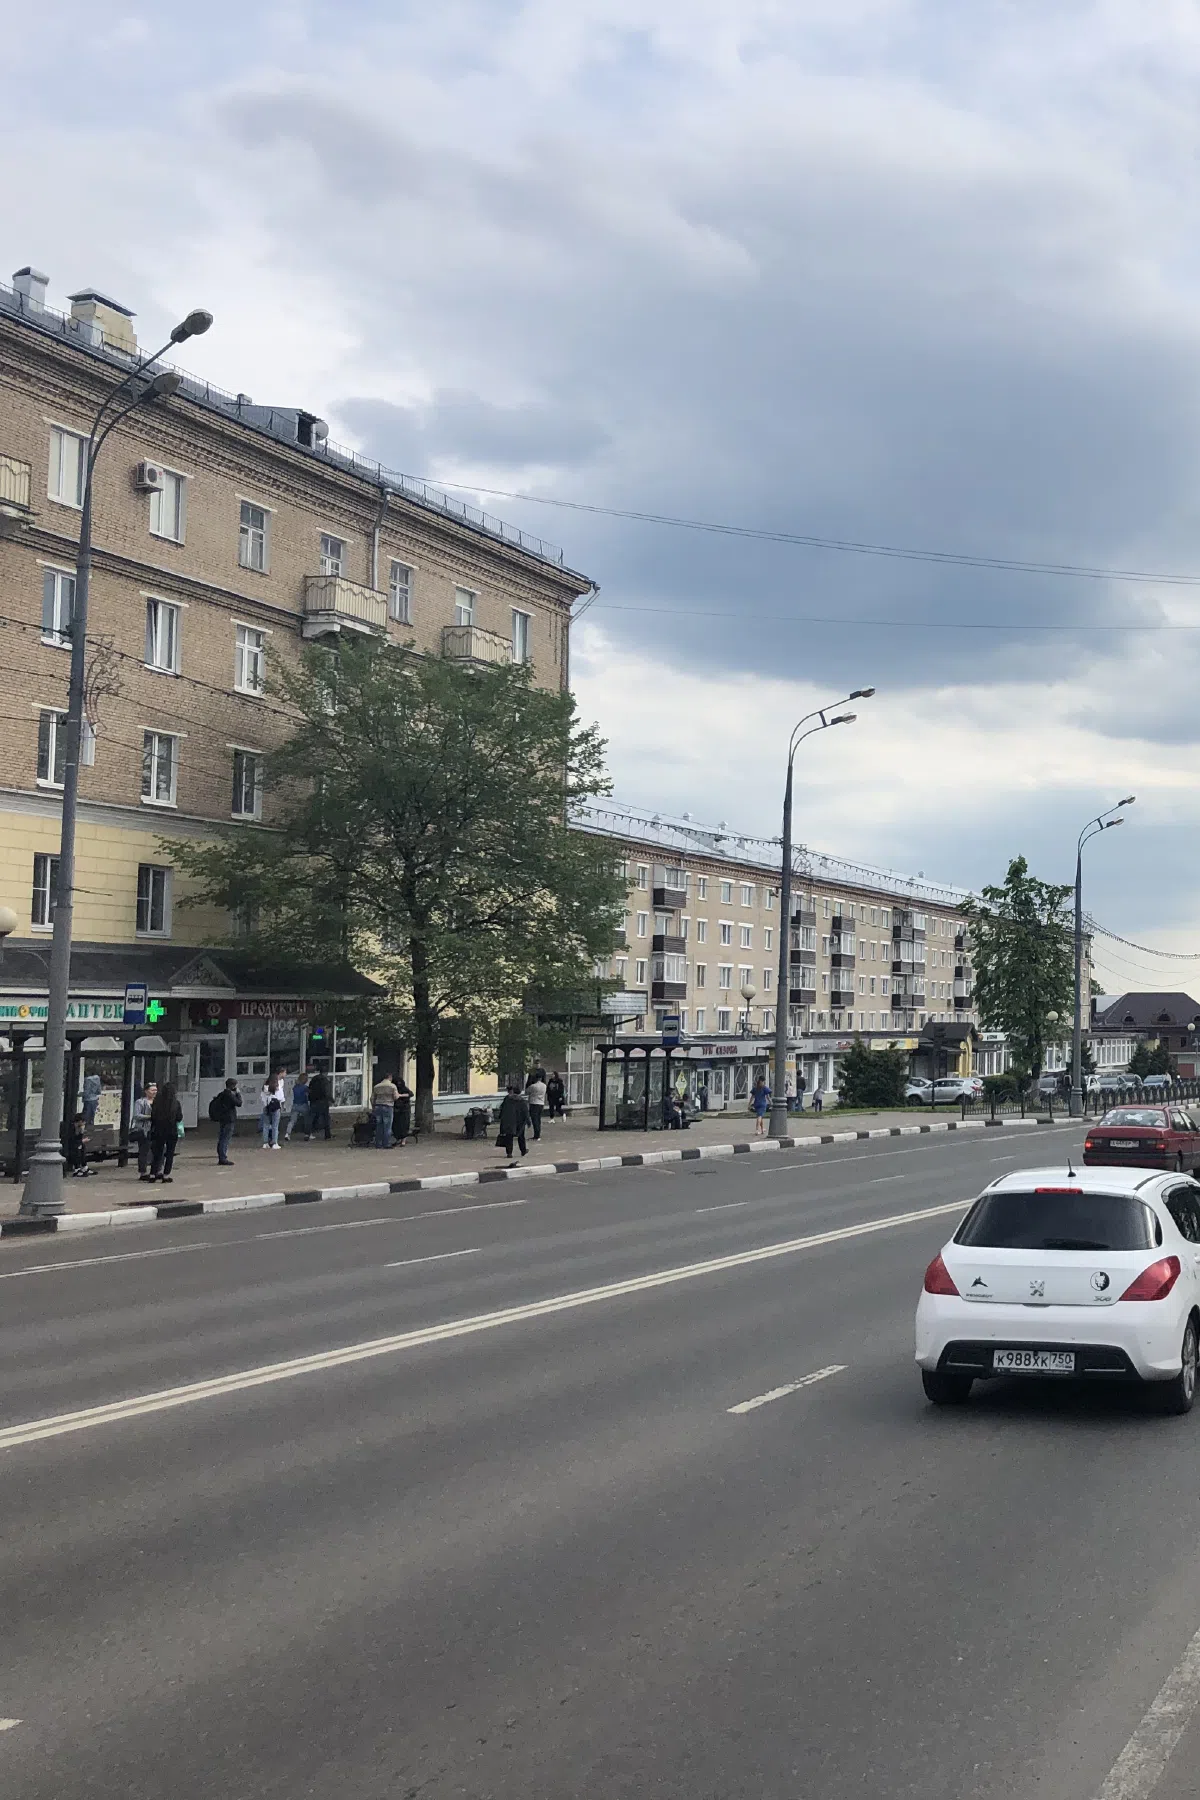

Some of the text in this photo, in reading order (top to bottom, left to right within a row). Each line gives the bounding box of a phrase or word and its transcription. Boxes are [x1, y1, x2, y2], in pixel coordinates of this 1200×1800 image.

[67, 1003, 124, 1018] АПТЕК
[240, 1002, 307, 1017] ПРОДУКТЫ
[1051, 1353, 1071, 1365] 750
